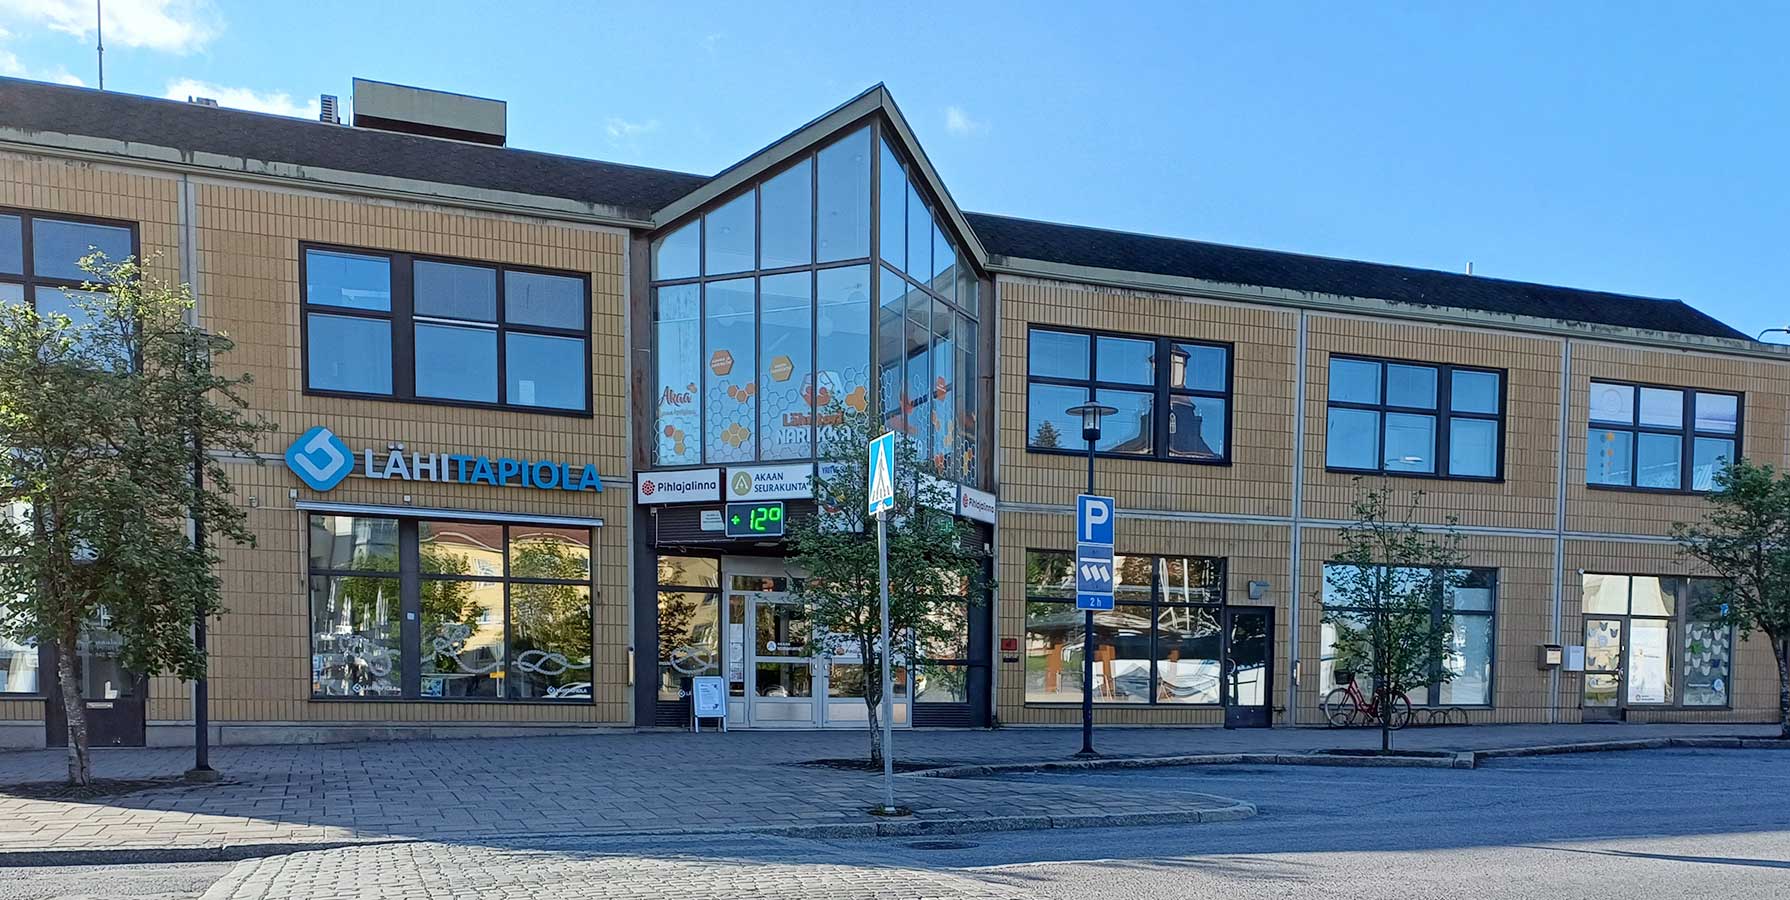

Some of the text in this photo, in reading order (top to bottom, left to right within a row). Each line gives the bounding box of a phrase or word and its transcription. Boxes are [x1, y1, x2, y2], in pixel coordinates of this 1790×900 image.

[658, 386, 692, 407] Akaa
[364, 443, 604, 492] LÄHITAPIOLA
[754, 472, 784, 482] AKAAN
[657, 480, 717, 494] Pihlajalinna
[754, 482, 807, 493] SEURAKUNTA
[1085, 499, 1109, 540] P
[1089, 597, 1102, 607] 2 h
